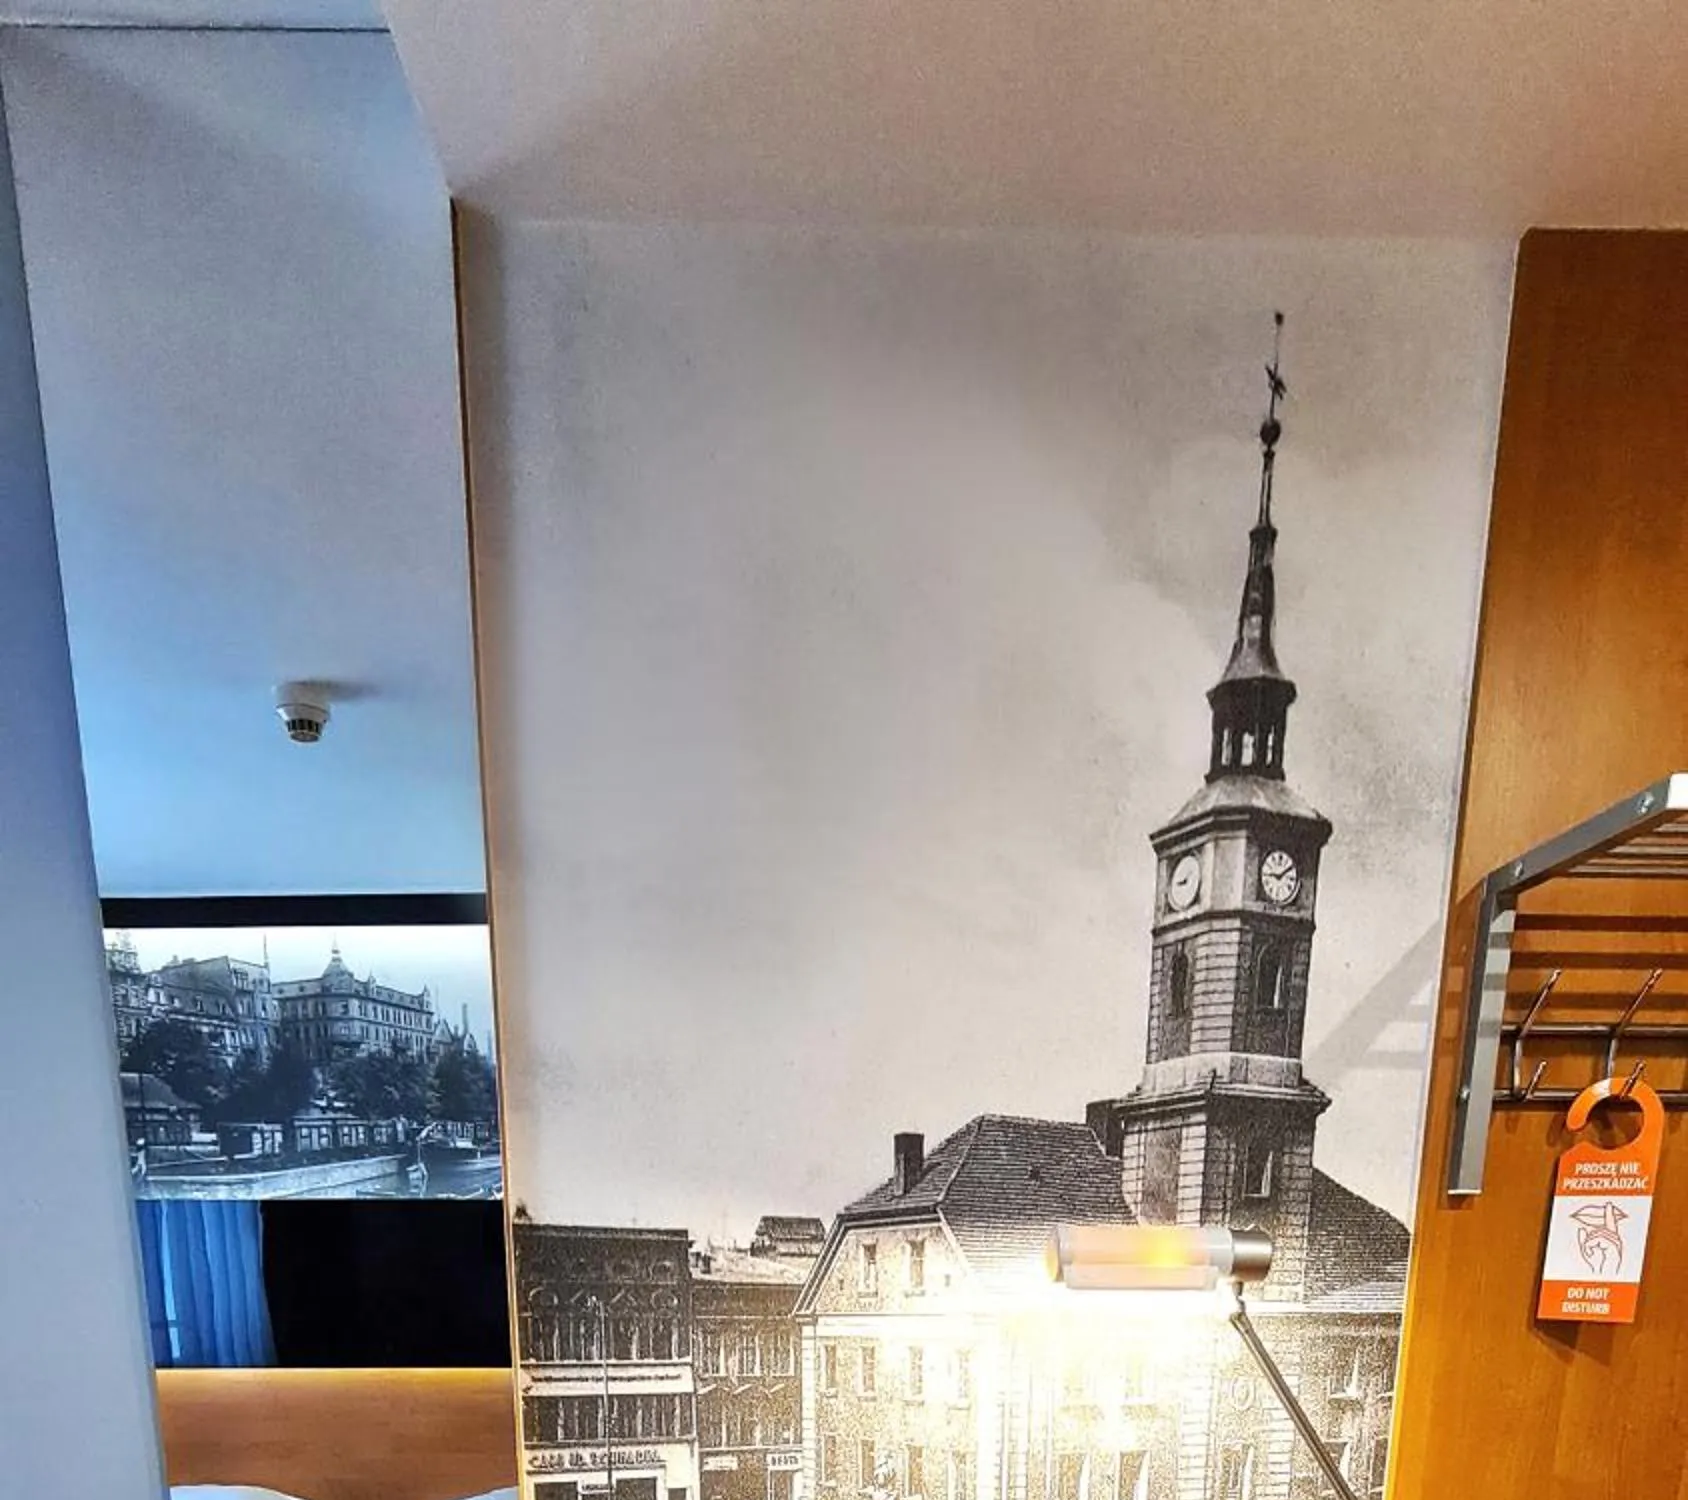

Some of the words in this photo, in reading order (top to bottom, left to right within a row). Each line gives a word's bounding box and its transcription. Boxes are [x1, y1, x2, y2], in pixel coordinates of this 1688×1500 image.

[1575, 1162, 1617, 1176] PROSZĘ
[1619, 1161, 1640, 1174] NIE
[1567, 1287, 1584, 1299] DO
[1585, 1287, 1611, 1301] NOT
